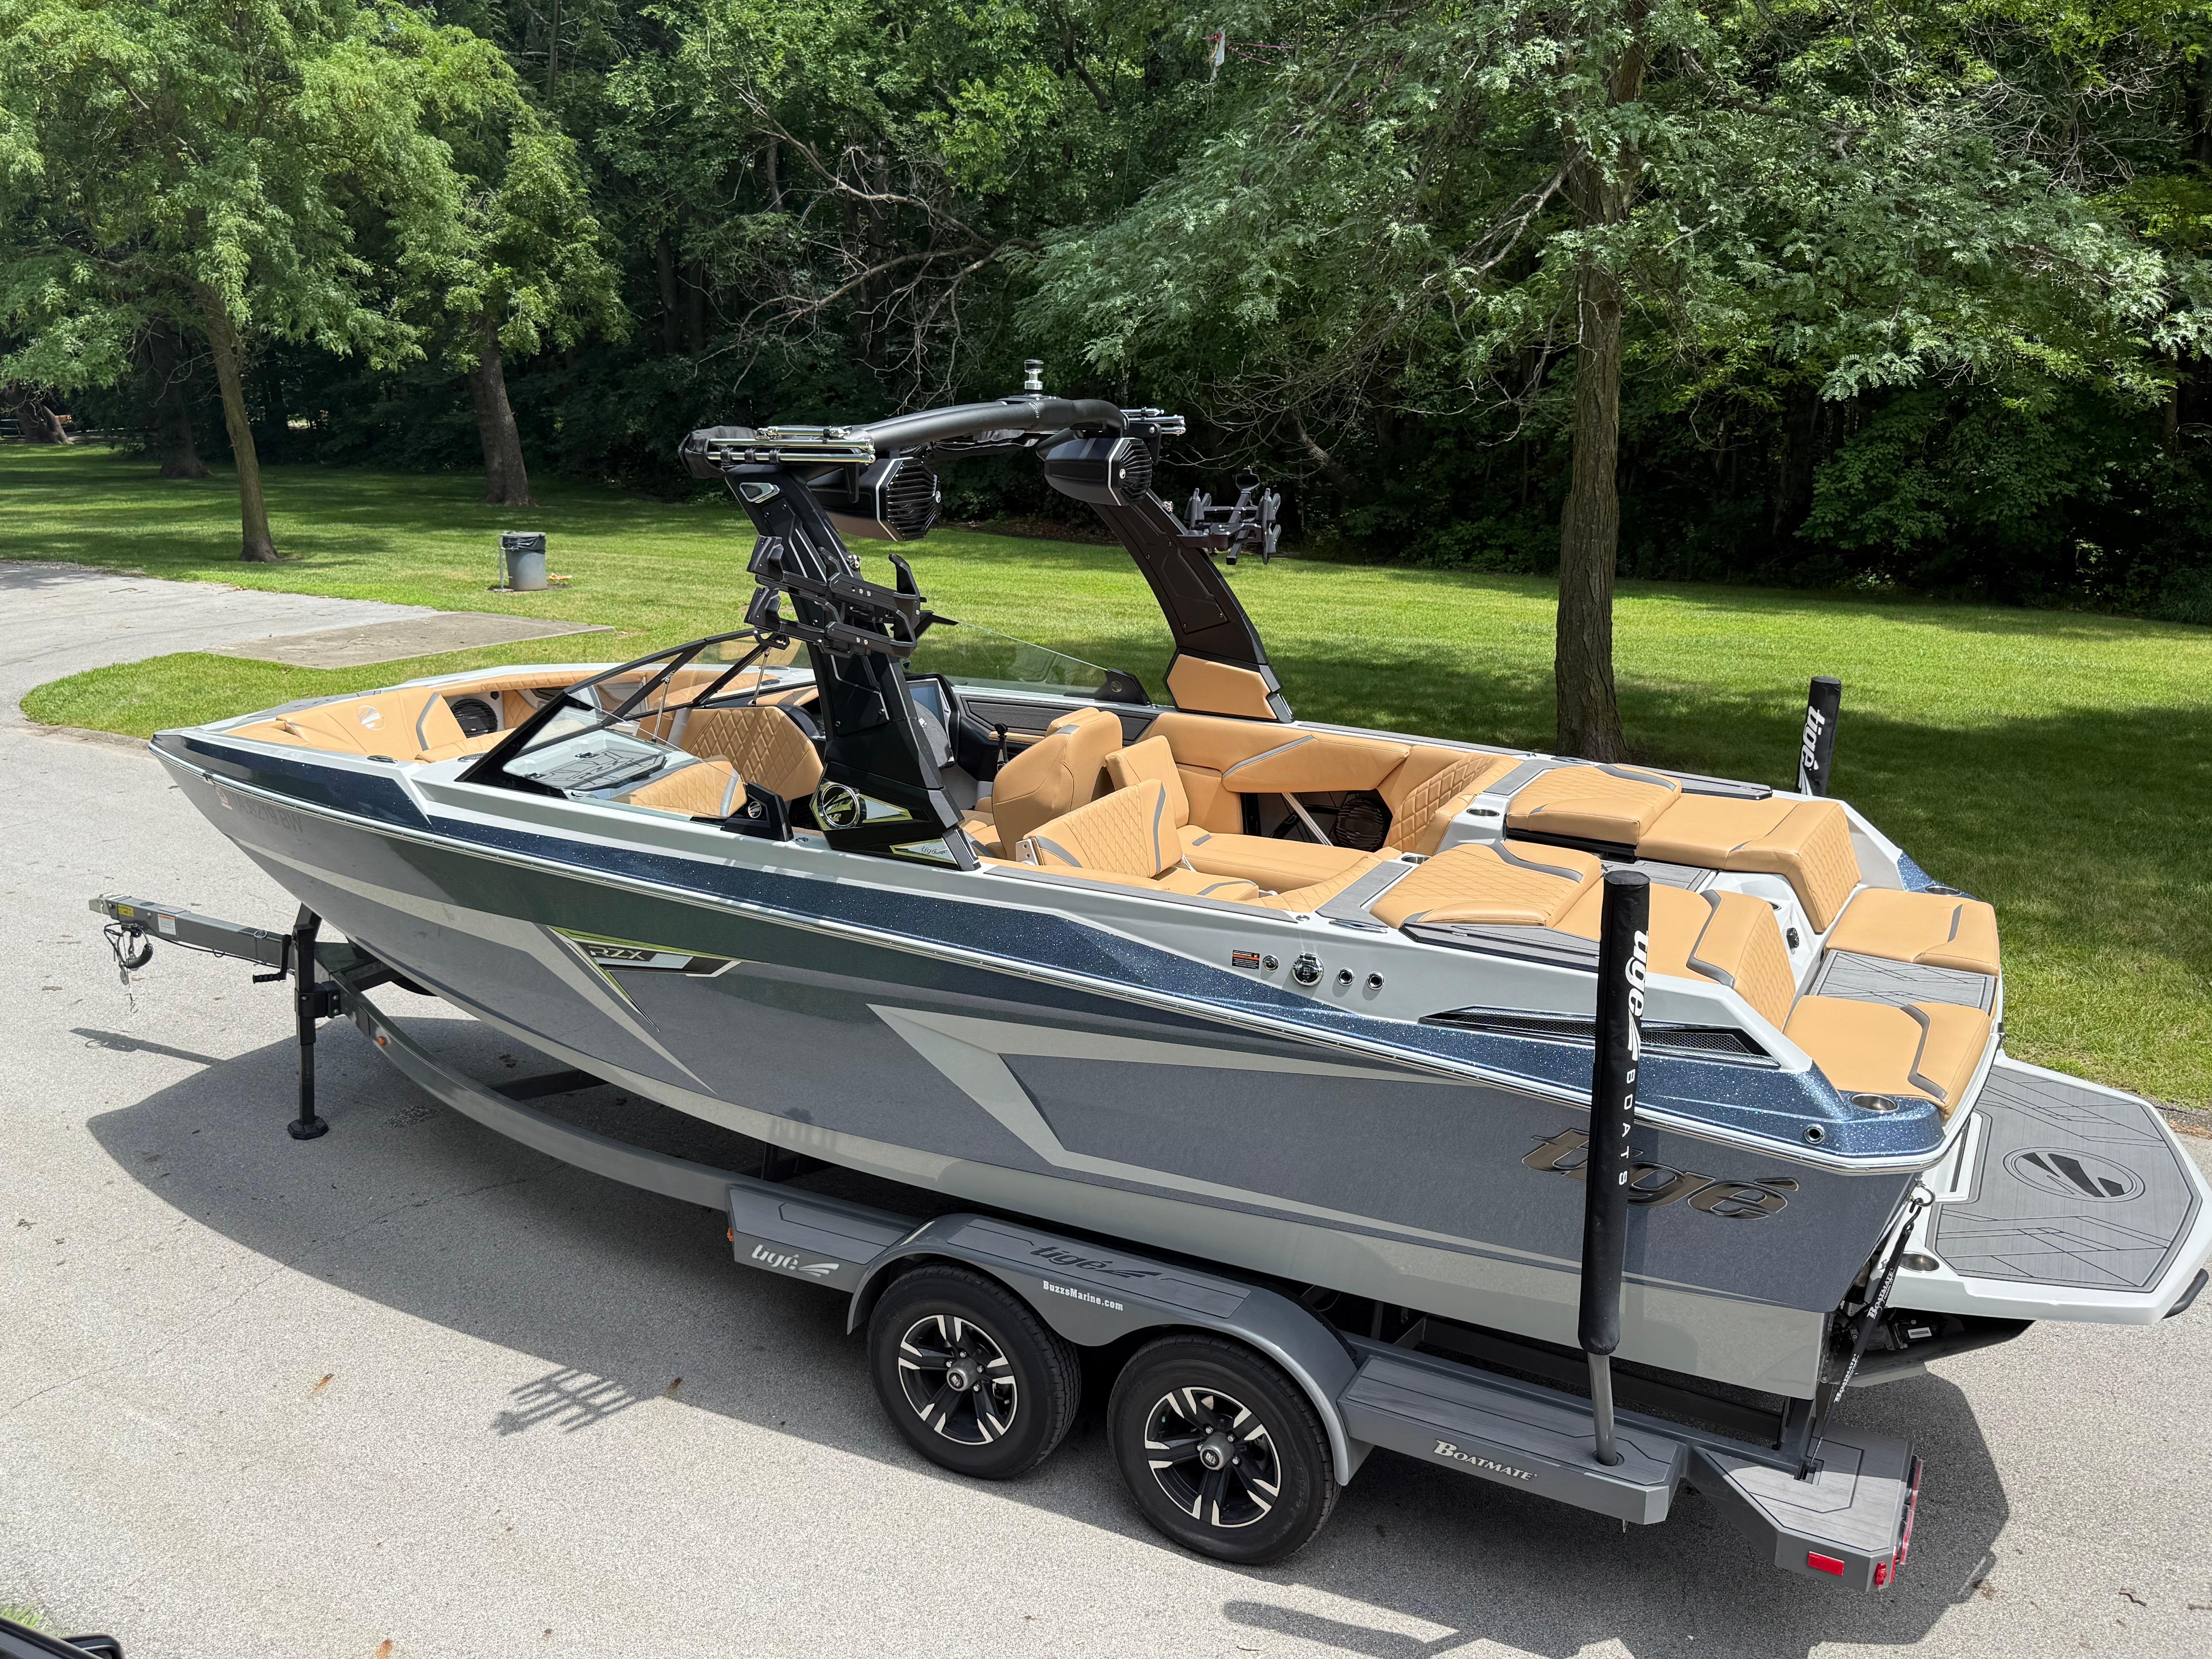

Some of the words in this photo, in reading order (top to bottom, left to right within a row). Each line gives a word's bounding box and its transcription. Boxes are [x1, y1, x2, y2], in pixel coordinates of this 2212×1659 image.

[278, 809, 303, 833] BW
[588, 945, 646, 960] RZX
[1619, 1068, 1636, 1186] BOATS
[1043, 1280, 1123, 1311] BuzzsMarine.com
